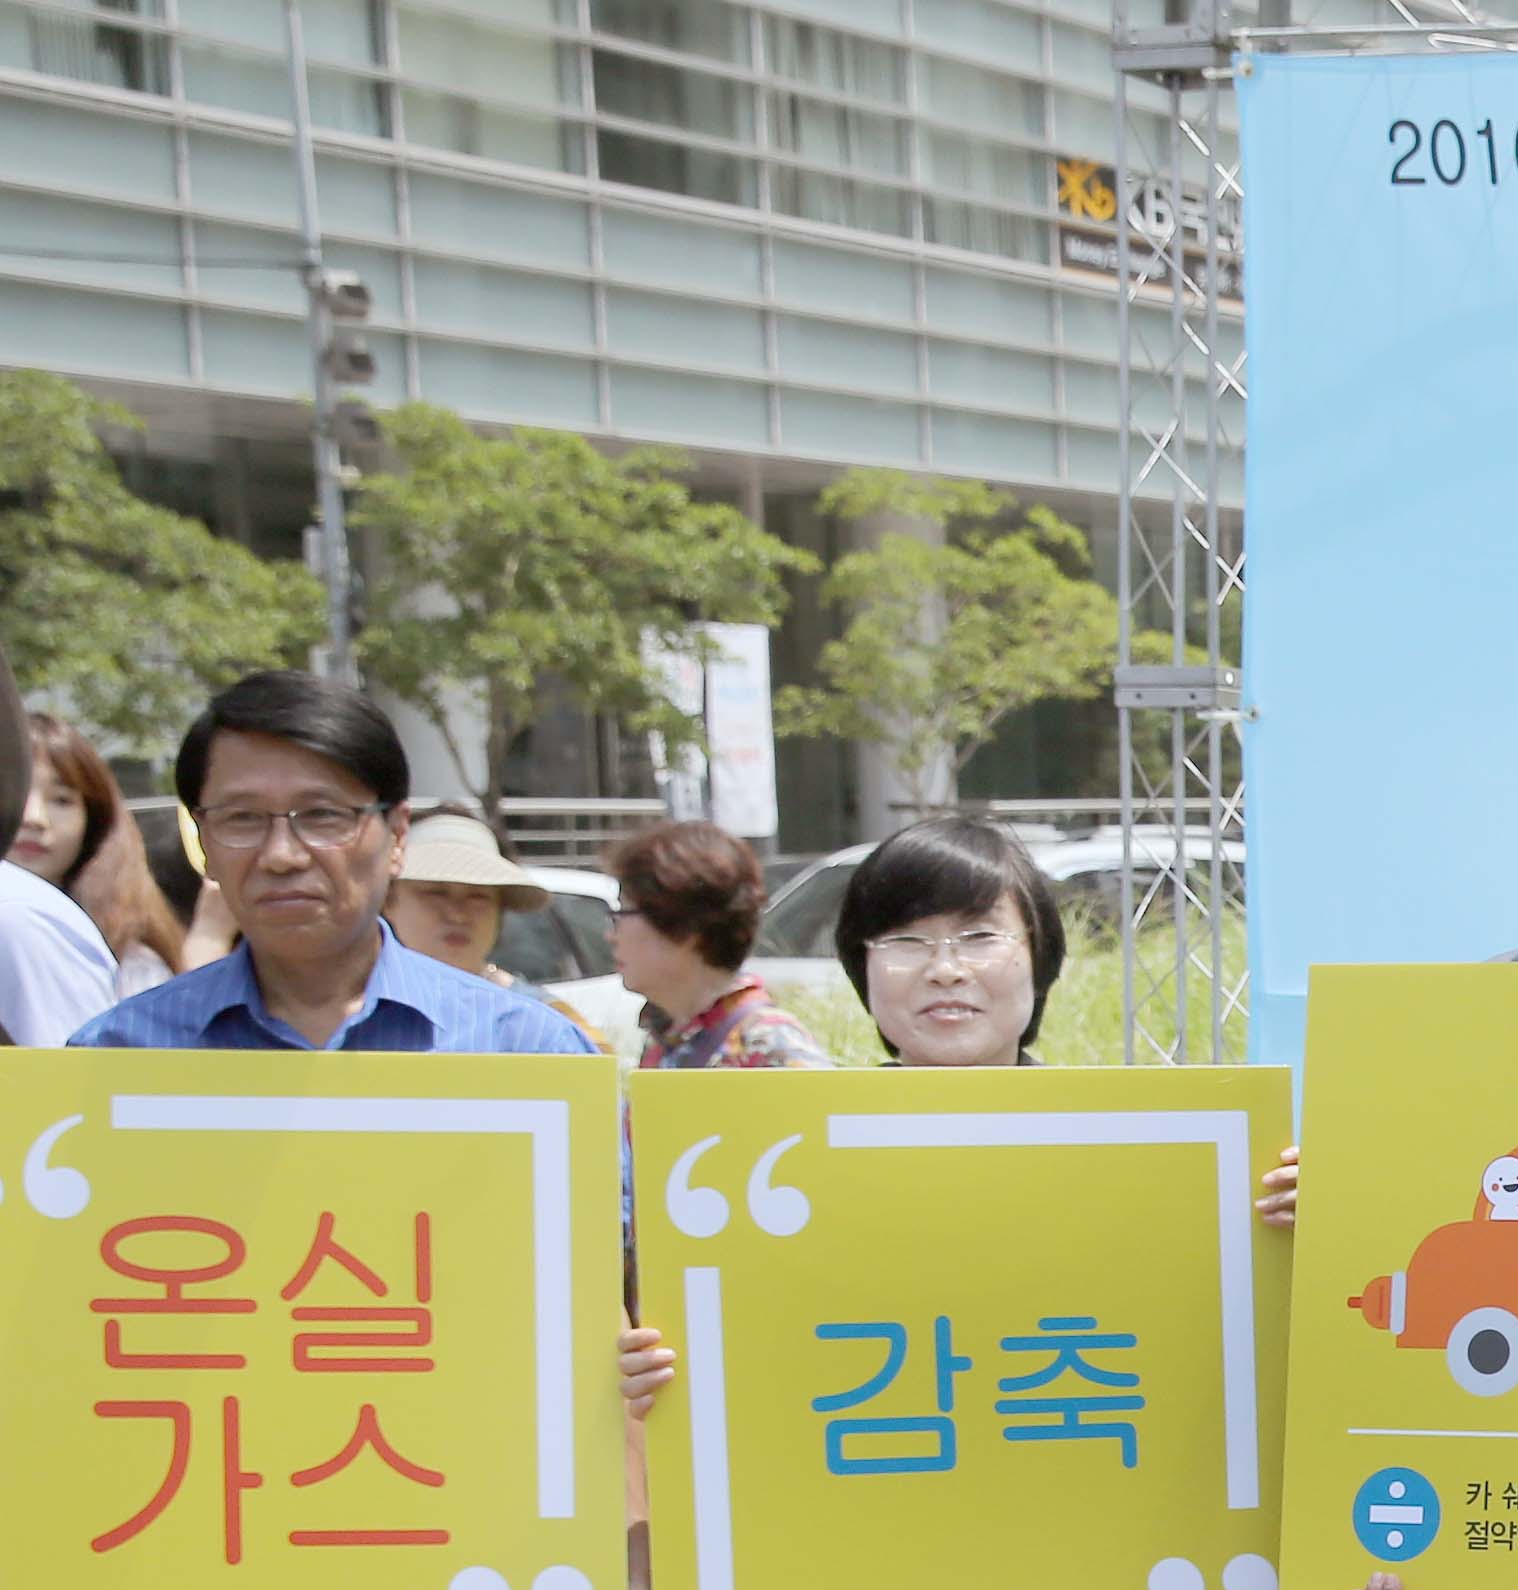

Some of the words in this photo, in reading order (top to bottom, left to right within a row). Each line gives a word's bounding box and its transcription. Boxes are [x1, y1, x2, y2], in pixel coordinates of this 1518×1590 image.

[88, 1210, 437, 1374] 온실
[811, 1315, 1146, 1476] 감축
[89, 1395, 452, 1567] 가스
[1465, 1480, 1492, 1511] 카
